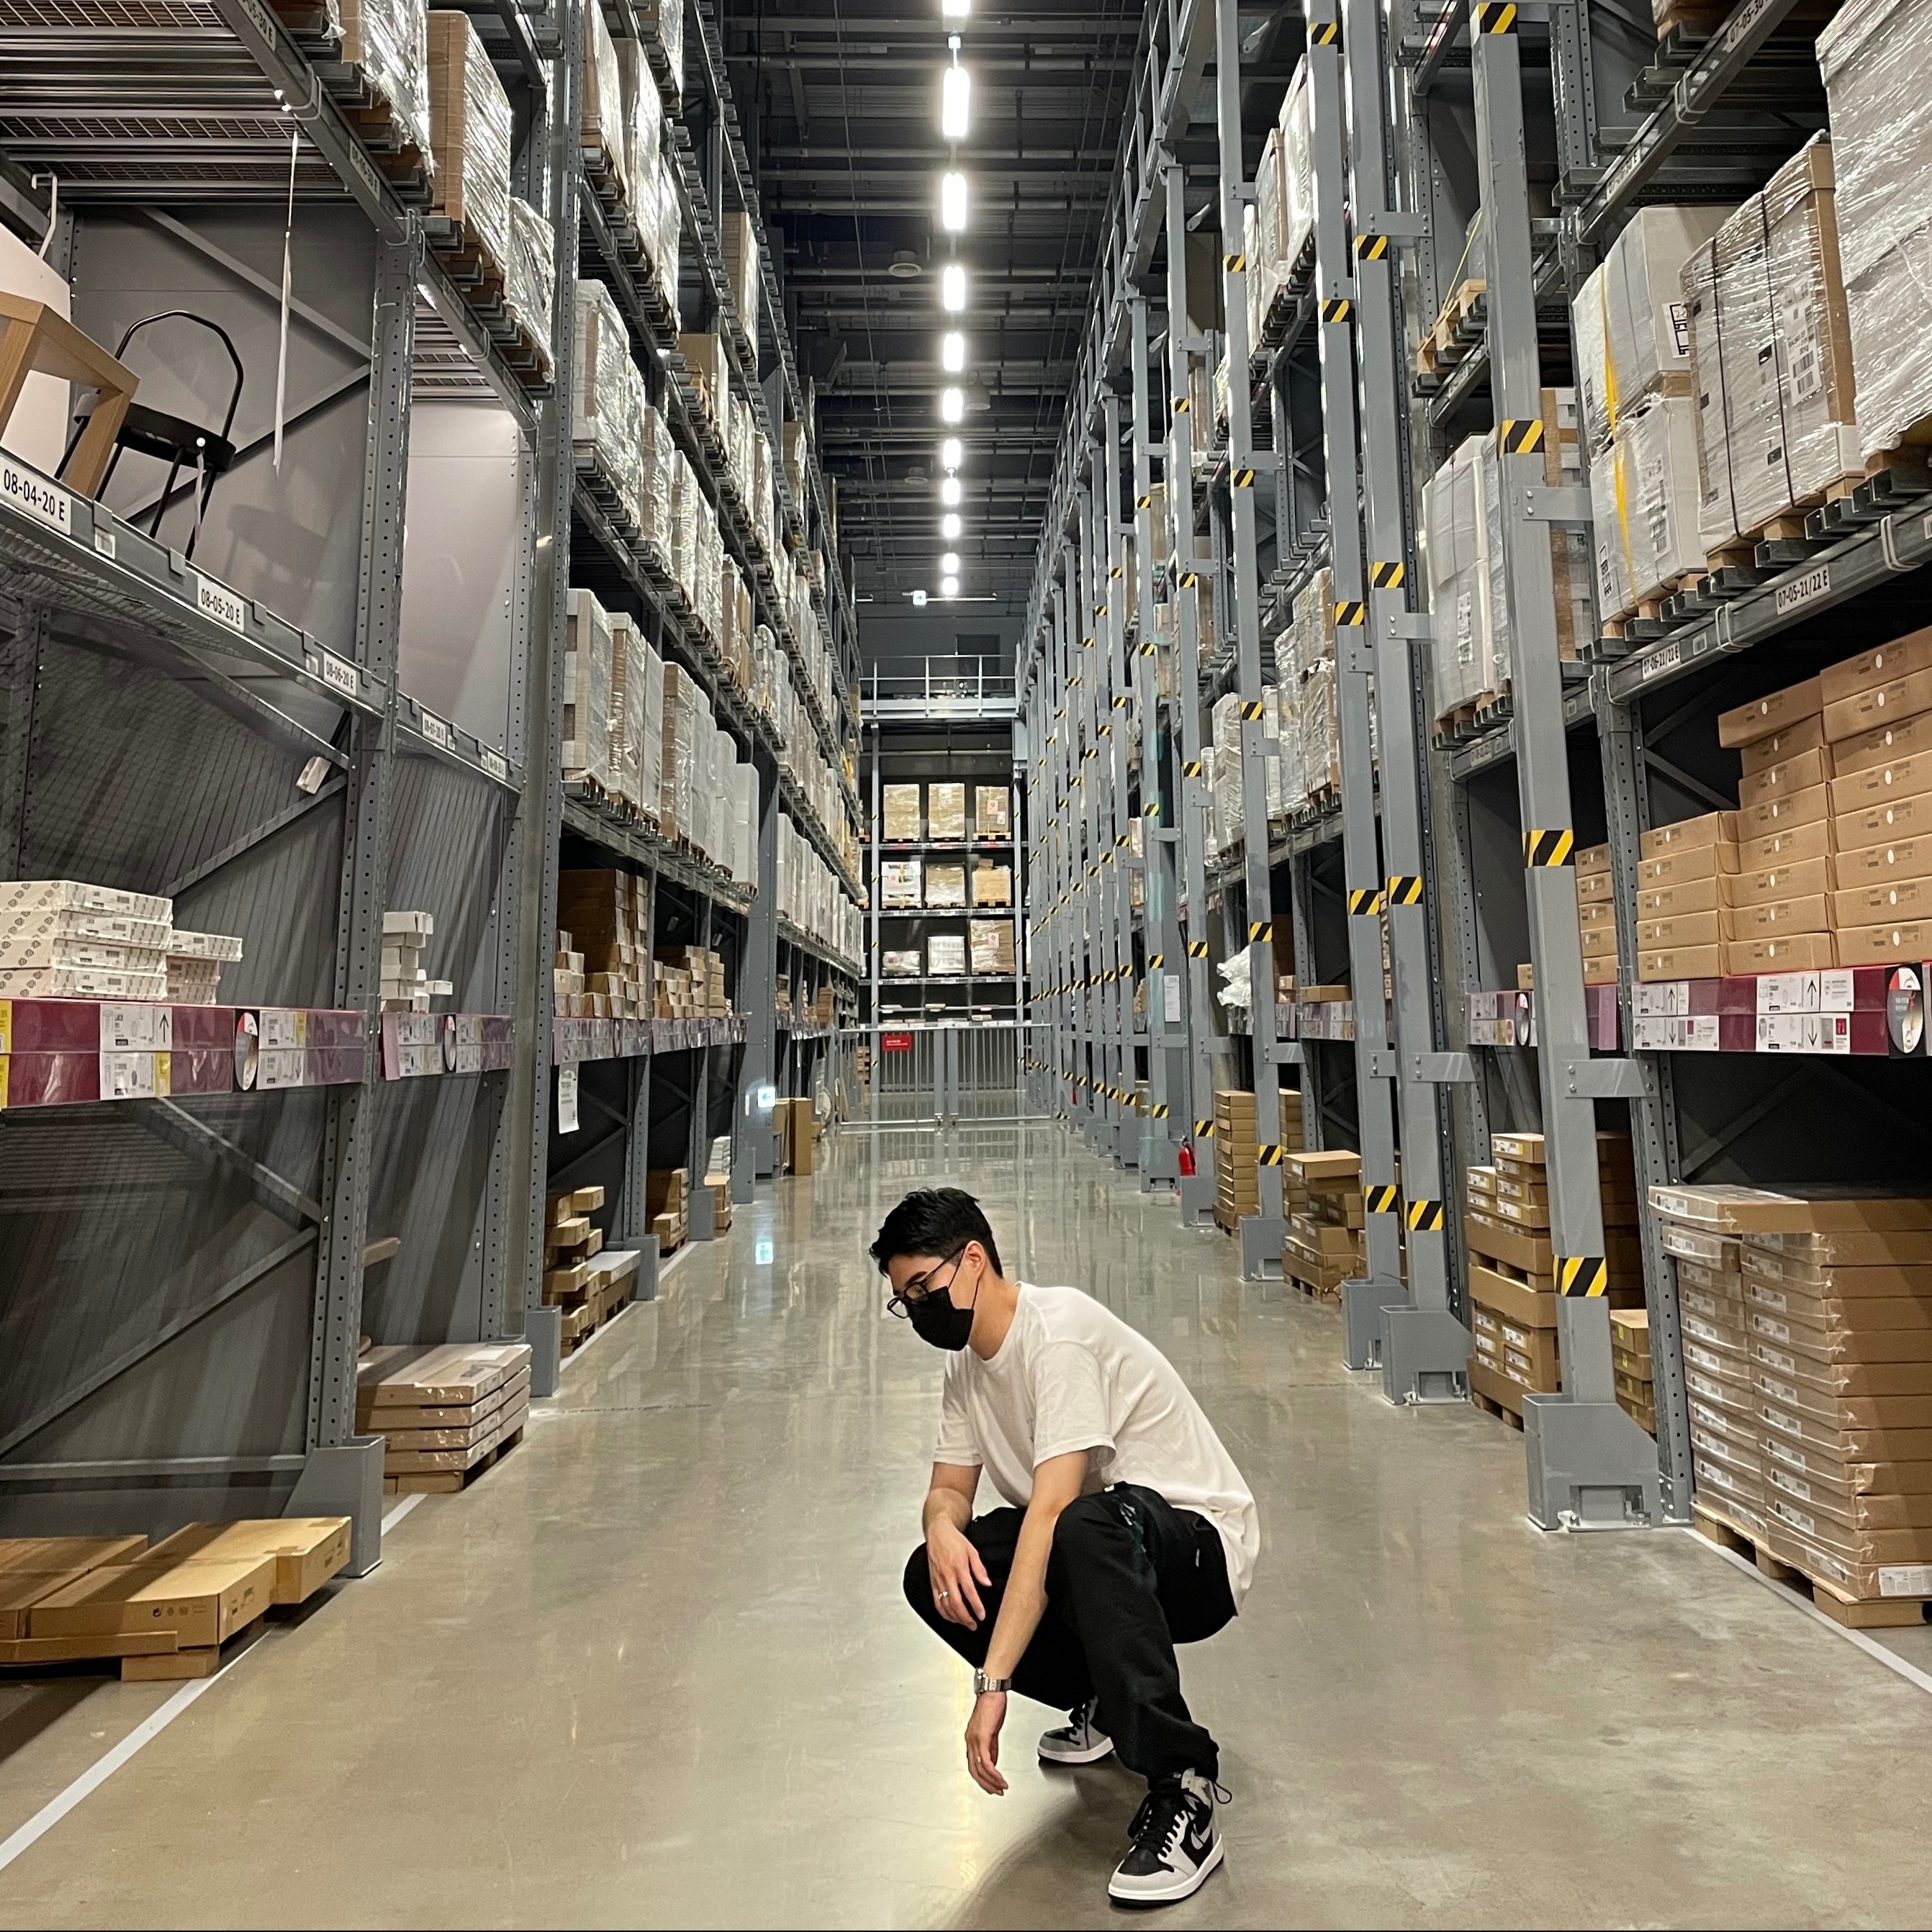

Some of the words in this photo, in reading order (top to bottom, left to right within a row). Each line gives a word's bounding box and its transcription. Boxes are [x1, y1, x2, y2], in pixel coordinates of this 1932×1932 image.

[268, 26, 273, 44] E
[4, 469, 55, 516] 08-04-20
[59, 500, 65, 522] E
[202, 588, 234, 621] 08-05-20
[235, 608, 240, 625] E
[1778, 572, 1822, 608] 07-05-21/22
[1823, 569, 1828, 587] E
[1675, 645, 1679, 659] E
